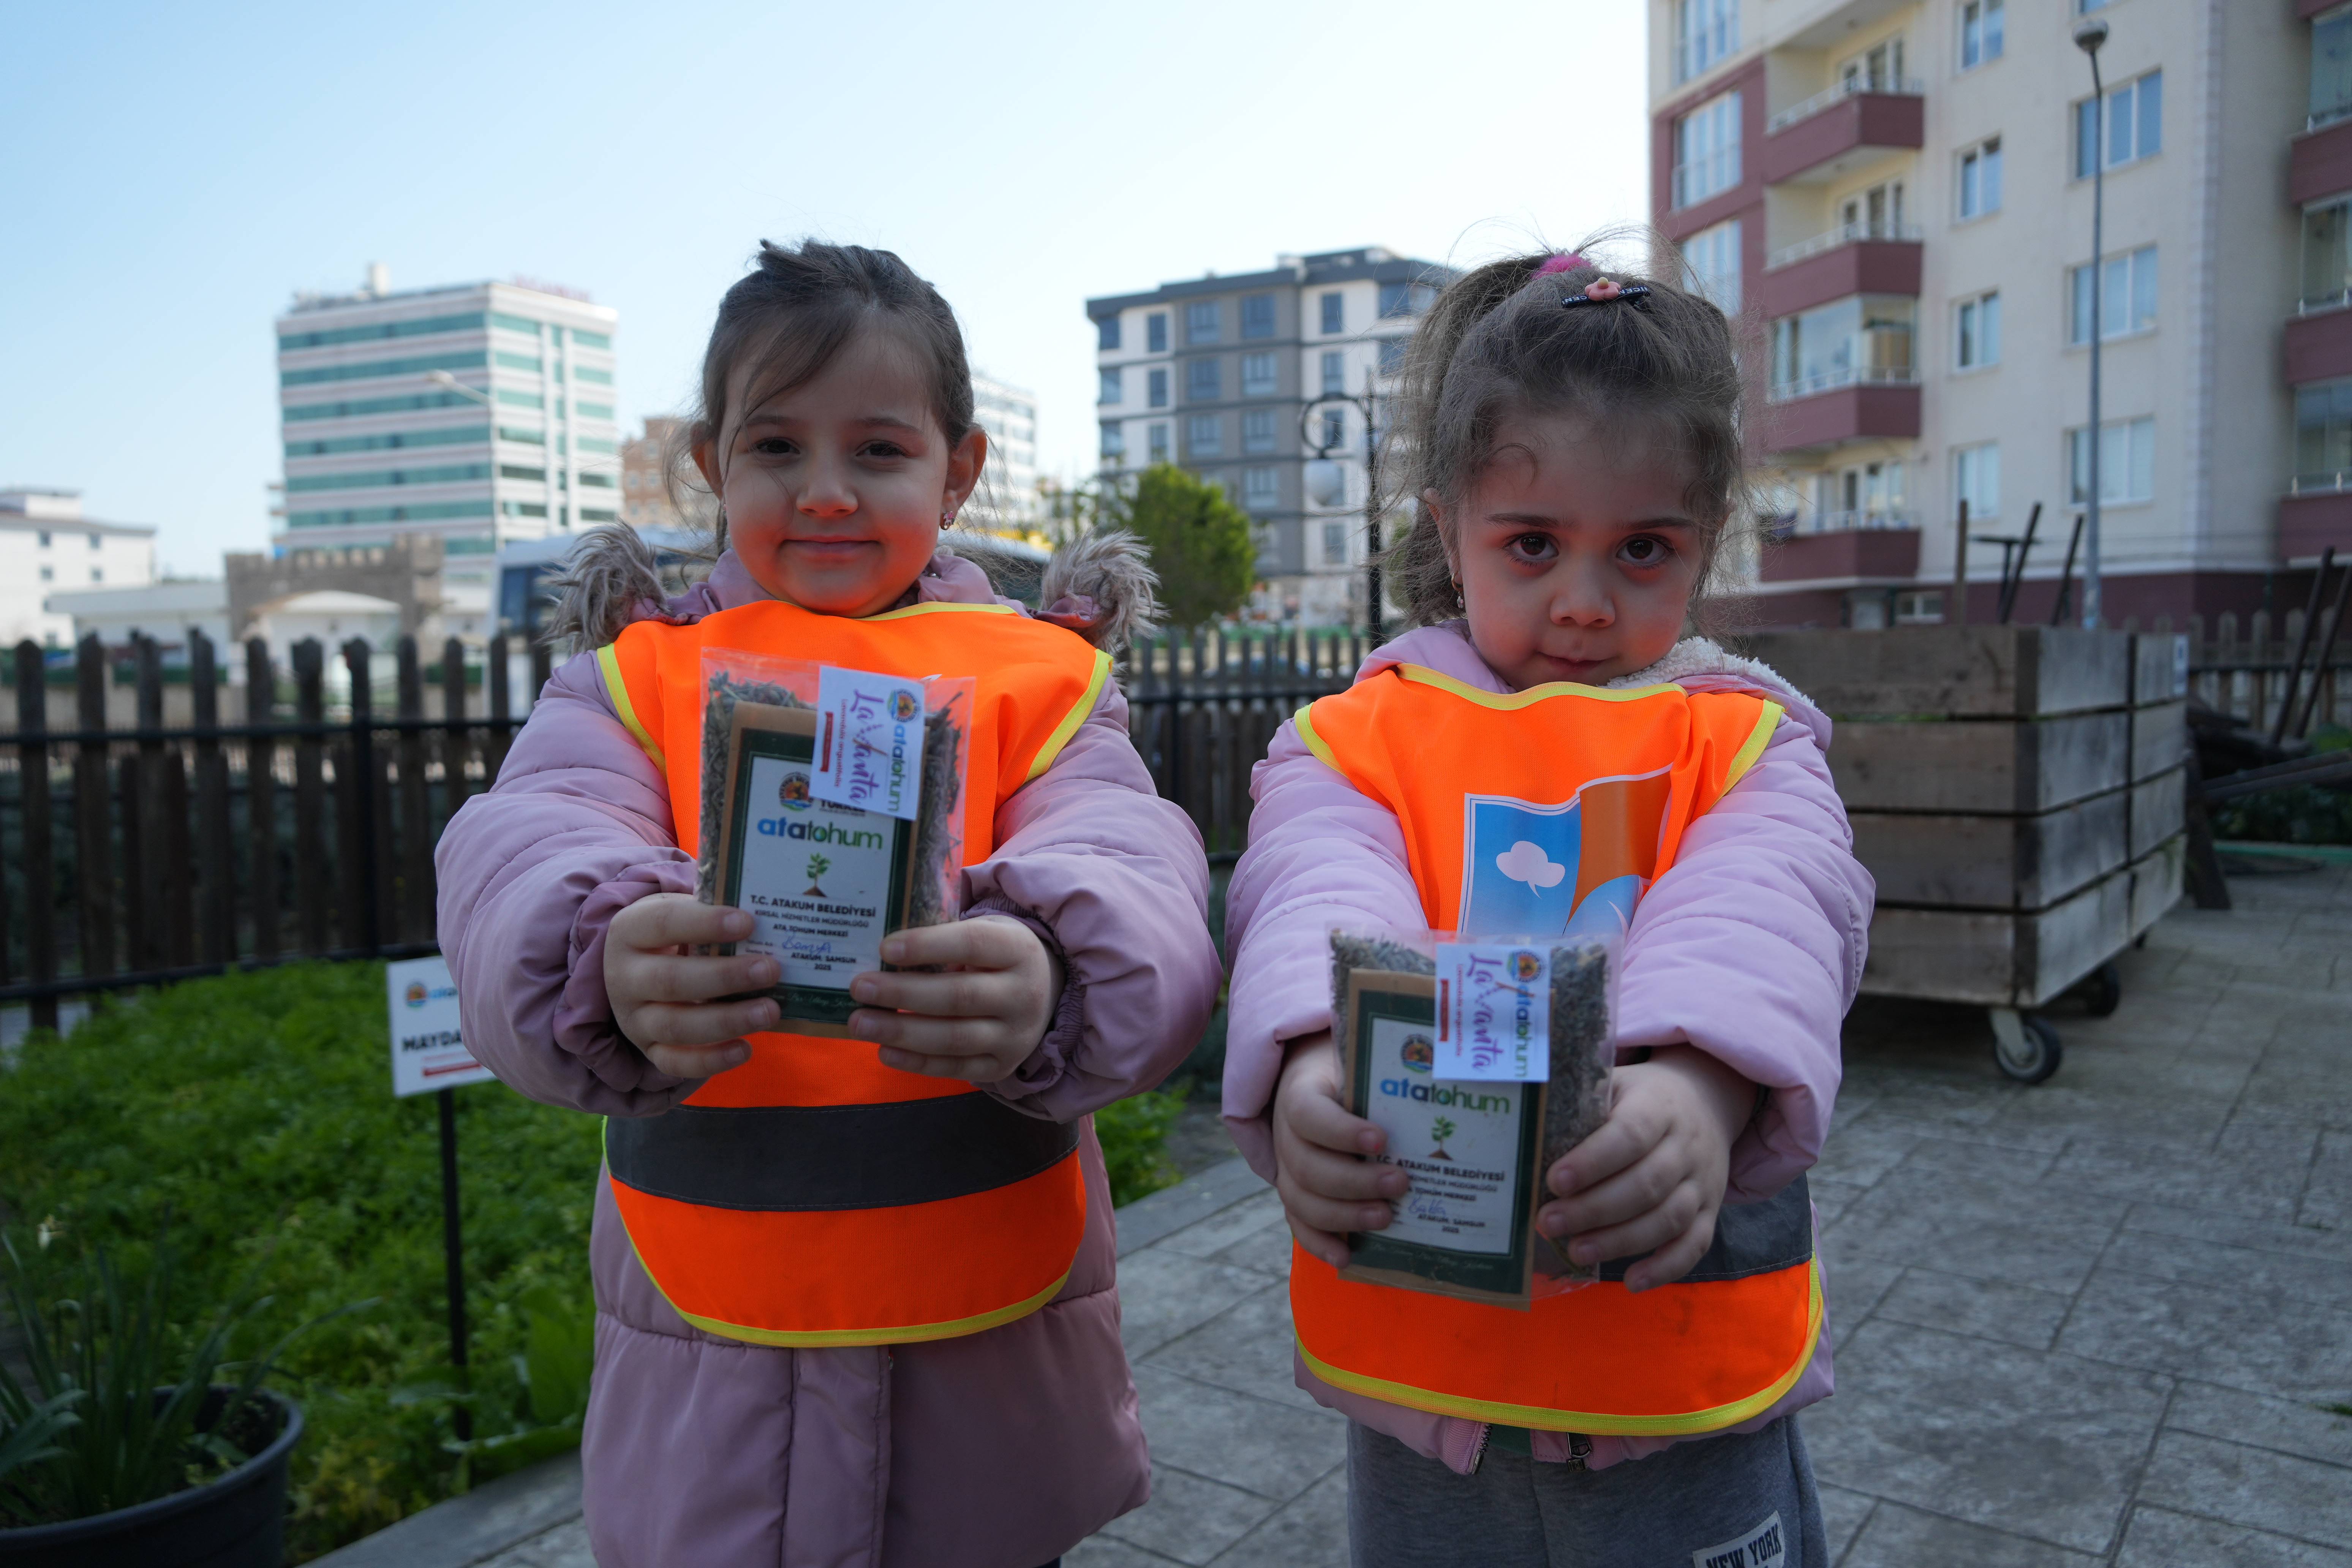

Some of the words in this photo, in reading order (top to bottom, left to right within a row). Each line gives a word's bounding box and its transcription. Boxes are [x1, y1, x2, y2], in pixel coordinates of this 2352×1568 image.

[758, 817, 882, 850] atatohum
[751, 895, 768, 905] T.C.
[771, 898, 814, 911] ATAKUM
[817, 904, 876, 917] BELEDİYESİ
[789, 926, 815, 935] TOHUM
[817, 929, 848, 937] MERKEZİ
[825, 955, 857, 964] SAMSUN
[1380, 1078, 1510, 1114] atatohum
[1397, 1159, 1441, 1174] ATAKUM
[1748, 1522, 1782, 1565] YORK
